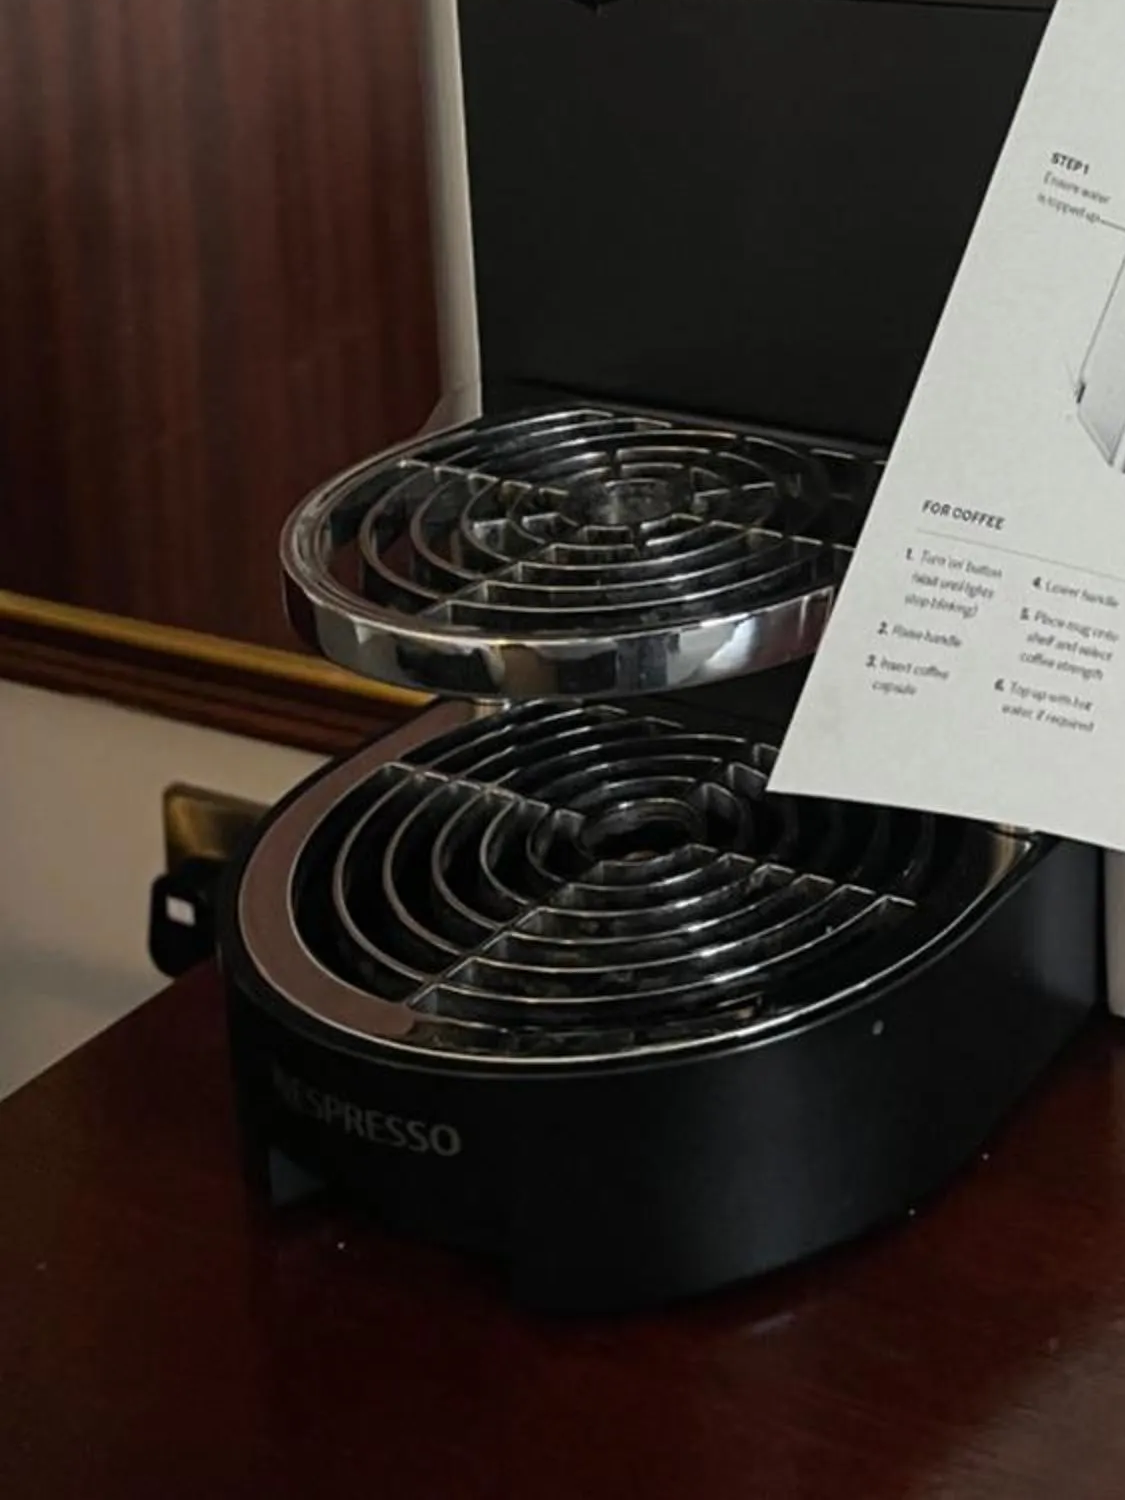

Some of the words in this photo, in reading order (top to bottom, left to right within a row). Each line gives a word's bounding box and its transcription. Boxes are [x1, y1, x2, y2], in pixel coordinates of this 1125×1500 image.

[1051, 152, 1083, 171] STEP
[922, 500, 951, 516] FOR
[952, 507, 1005, 530] COFFEE
